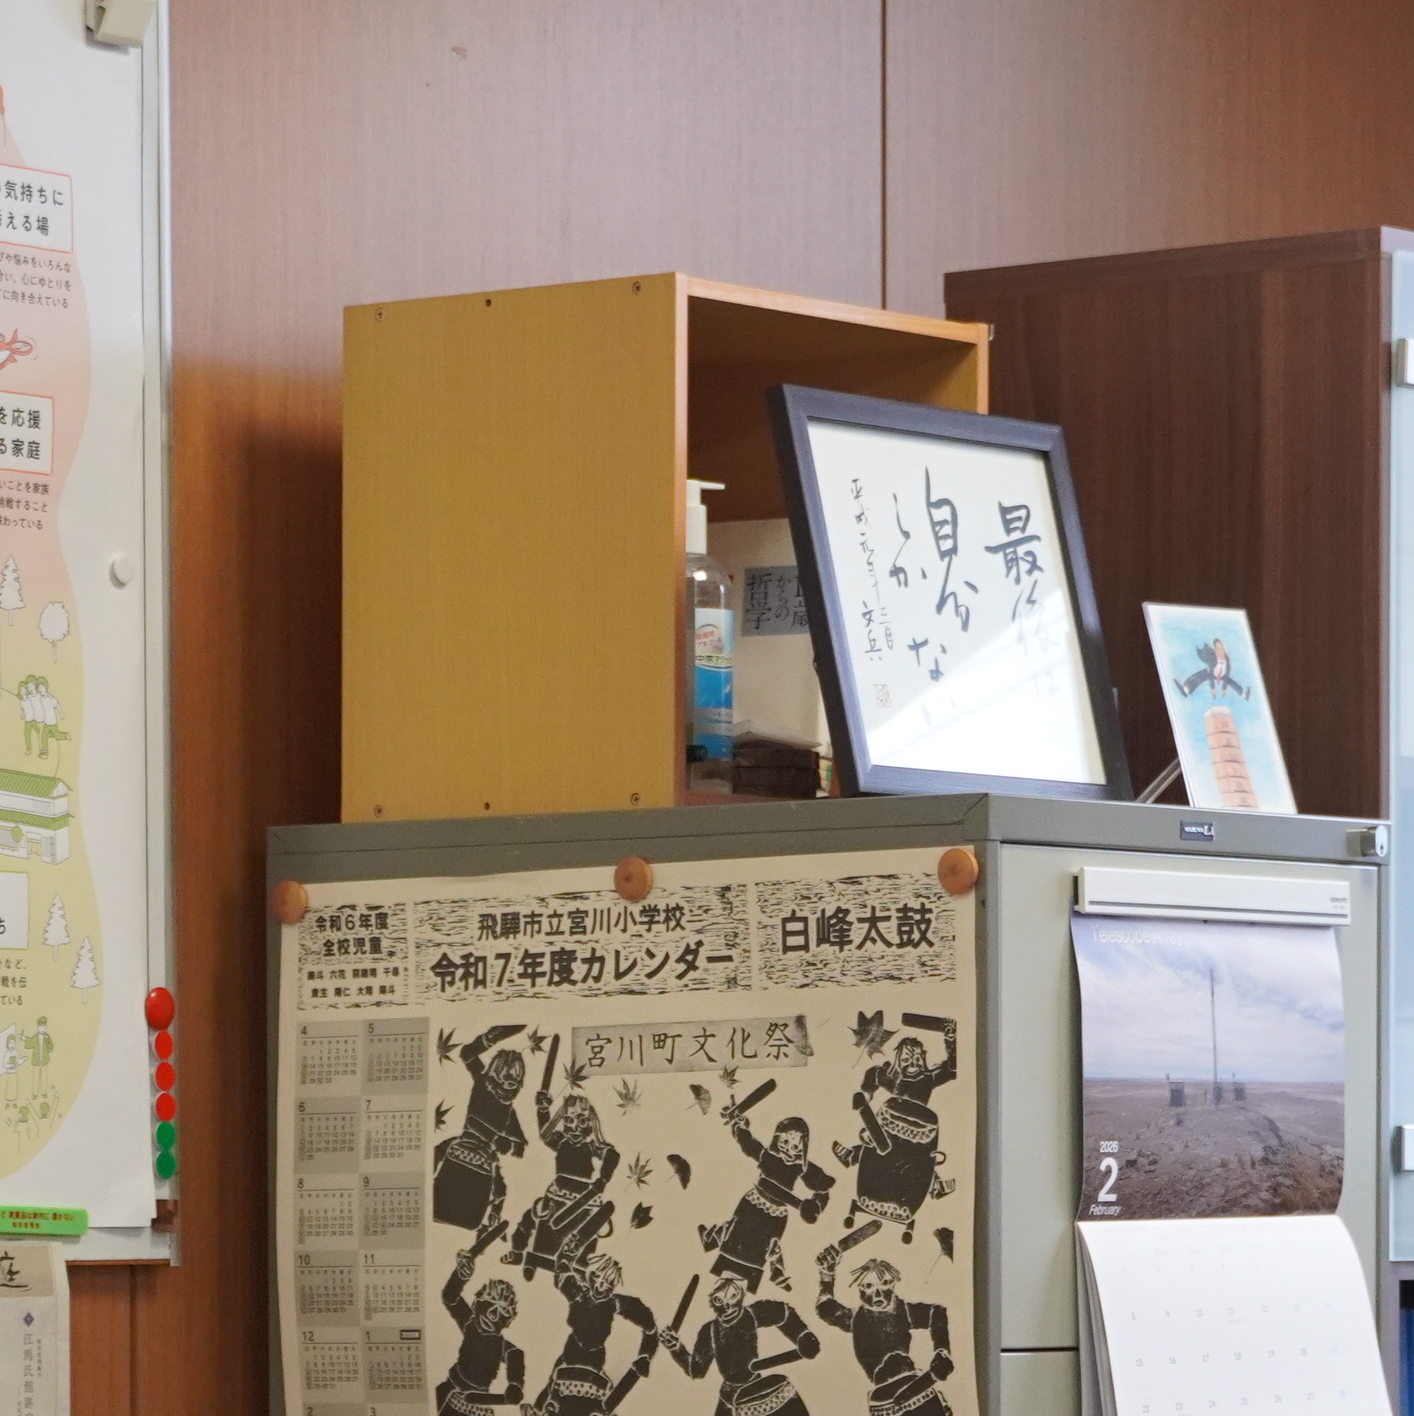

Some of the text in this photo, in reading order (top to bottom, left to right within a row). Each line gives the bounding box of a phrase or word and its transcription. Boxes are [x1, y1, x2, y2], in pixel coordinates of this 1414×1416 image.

[746, 573, 772, 630] 哲学
[315, 912, 389, 934] 令和6年度
[779, 898, 936, 956] 白峰太鼓
[323, 936, 383, 957] 全校児童
[430, 938, 735, 993] 令和7年度カレンダー
[301, 1026, 307, 1035] 4
[367, 1023, 374, 1033] 5
[585, 1022, 795, 1069] 宮川町文化祭
[299, 1102, 305, 1112] 6
[366, 1100, 372, 1110] 7
[1099, 1140, 1119, 1154] 2026
[297, 1178, 304, 1188] 8
[363, 1176, 370, 1187] 9
[1097, 1157, 1119, 1203] 2
[1089, 1203, 1122, 1217] February
[298, 1255, 311, 1265] 10
[364, 1254, 375, 1264] 11
[302, 1331, 314, 1341] 12
[365, 1331, 370, 1341] 1
